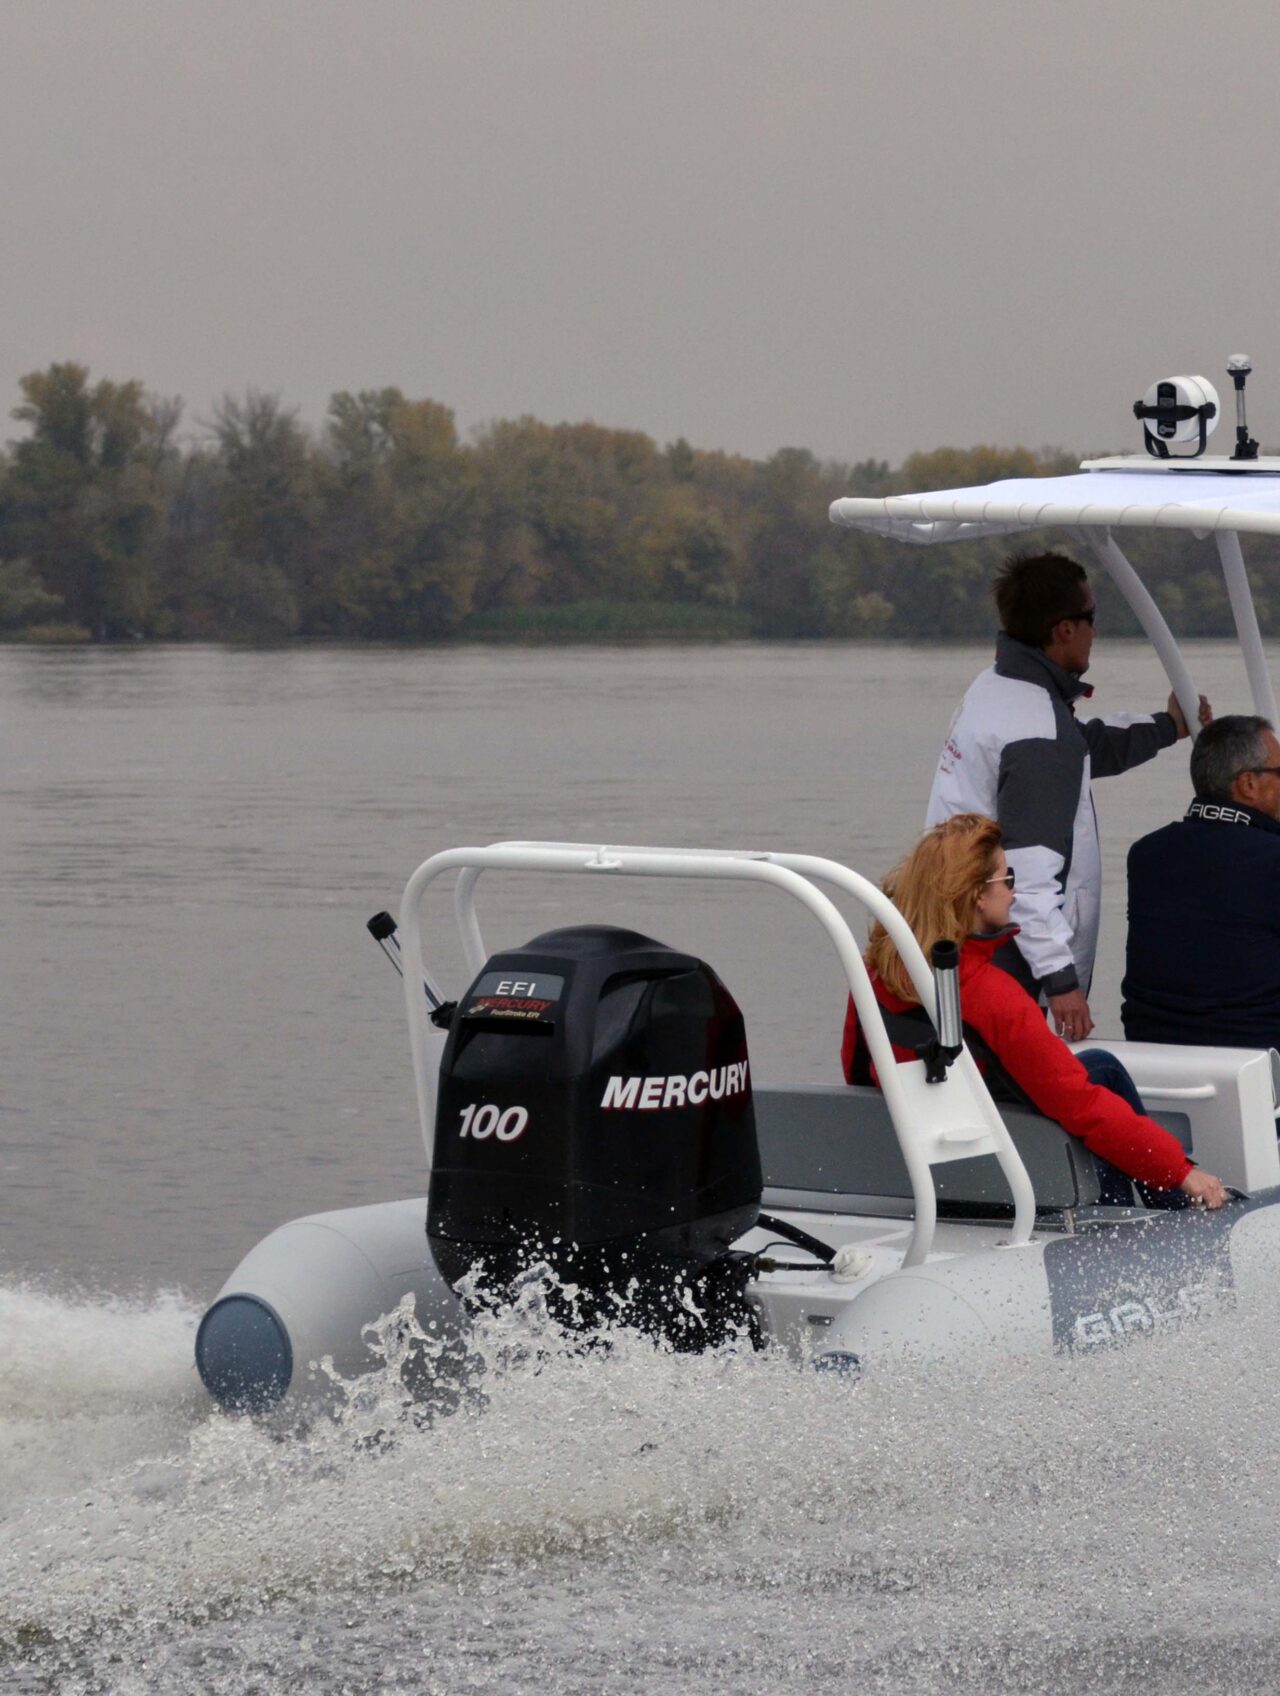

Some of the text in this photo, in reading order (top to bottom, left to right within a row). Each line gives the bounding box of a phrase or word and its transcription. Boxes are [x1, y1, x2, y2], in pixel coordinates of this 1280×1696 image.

[495, 980, 536, 997] EFI
[477, 997, 551, 1011] MERCURY
[600, 1060, 748, 1110] MERCURY
[458, 1103, 529, 1142] 100
